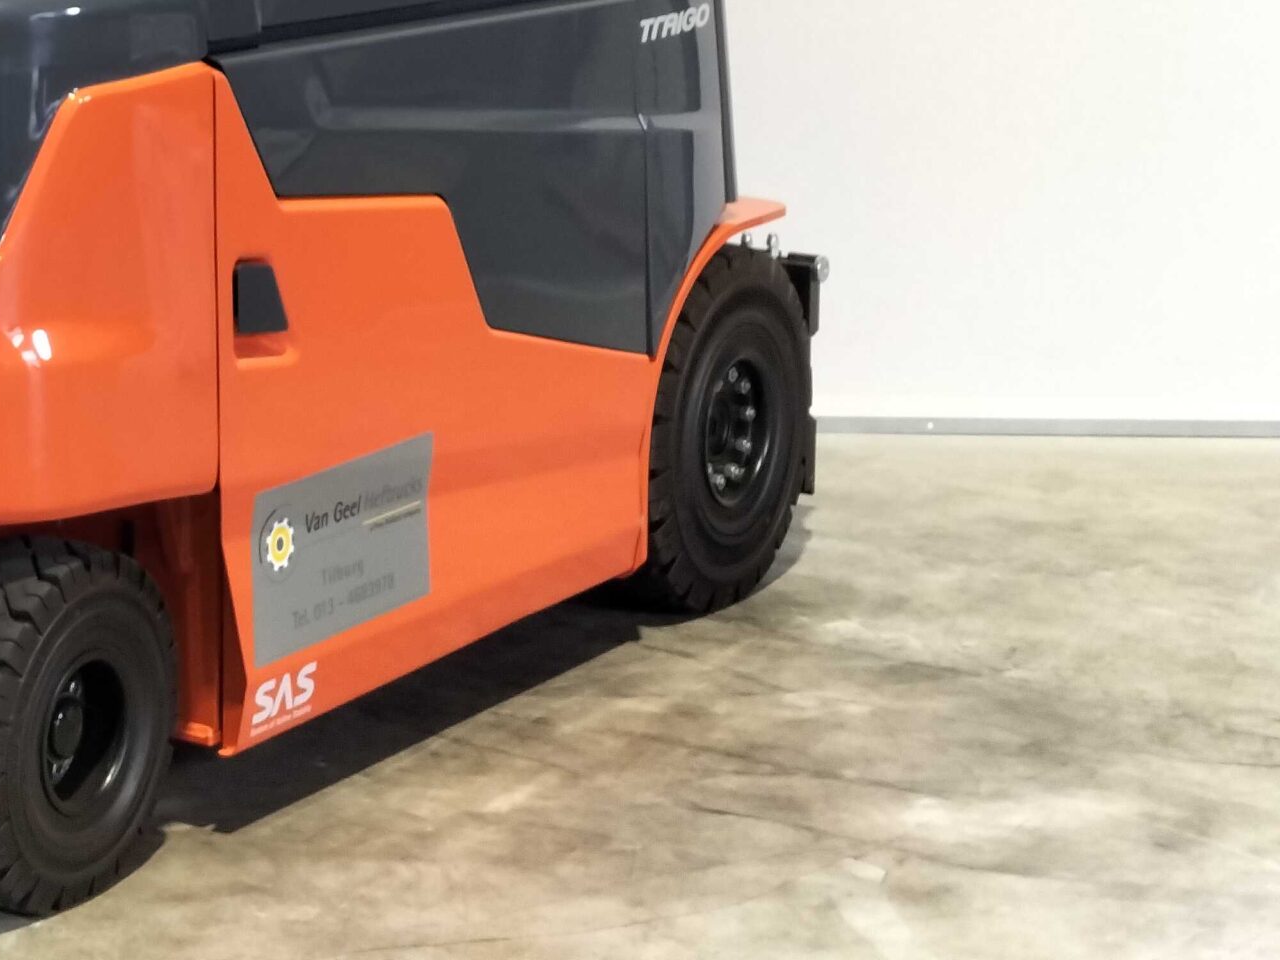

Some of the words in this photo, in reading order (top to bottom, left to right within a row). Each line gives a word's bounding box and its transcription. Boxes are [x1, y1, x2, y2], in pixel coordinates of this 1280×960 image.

[305, 512, 329, 533] Van
[333, 495, 362, 524] Geel
[252, 660, 318, 726] SAS
